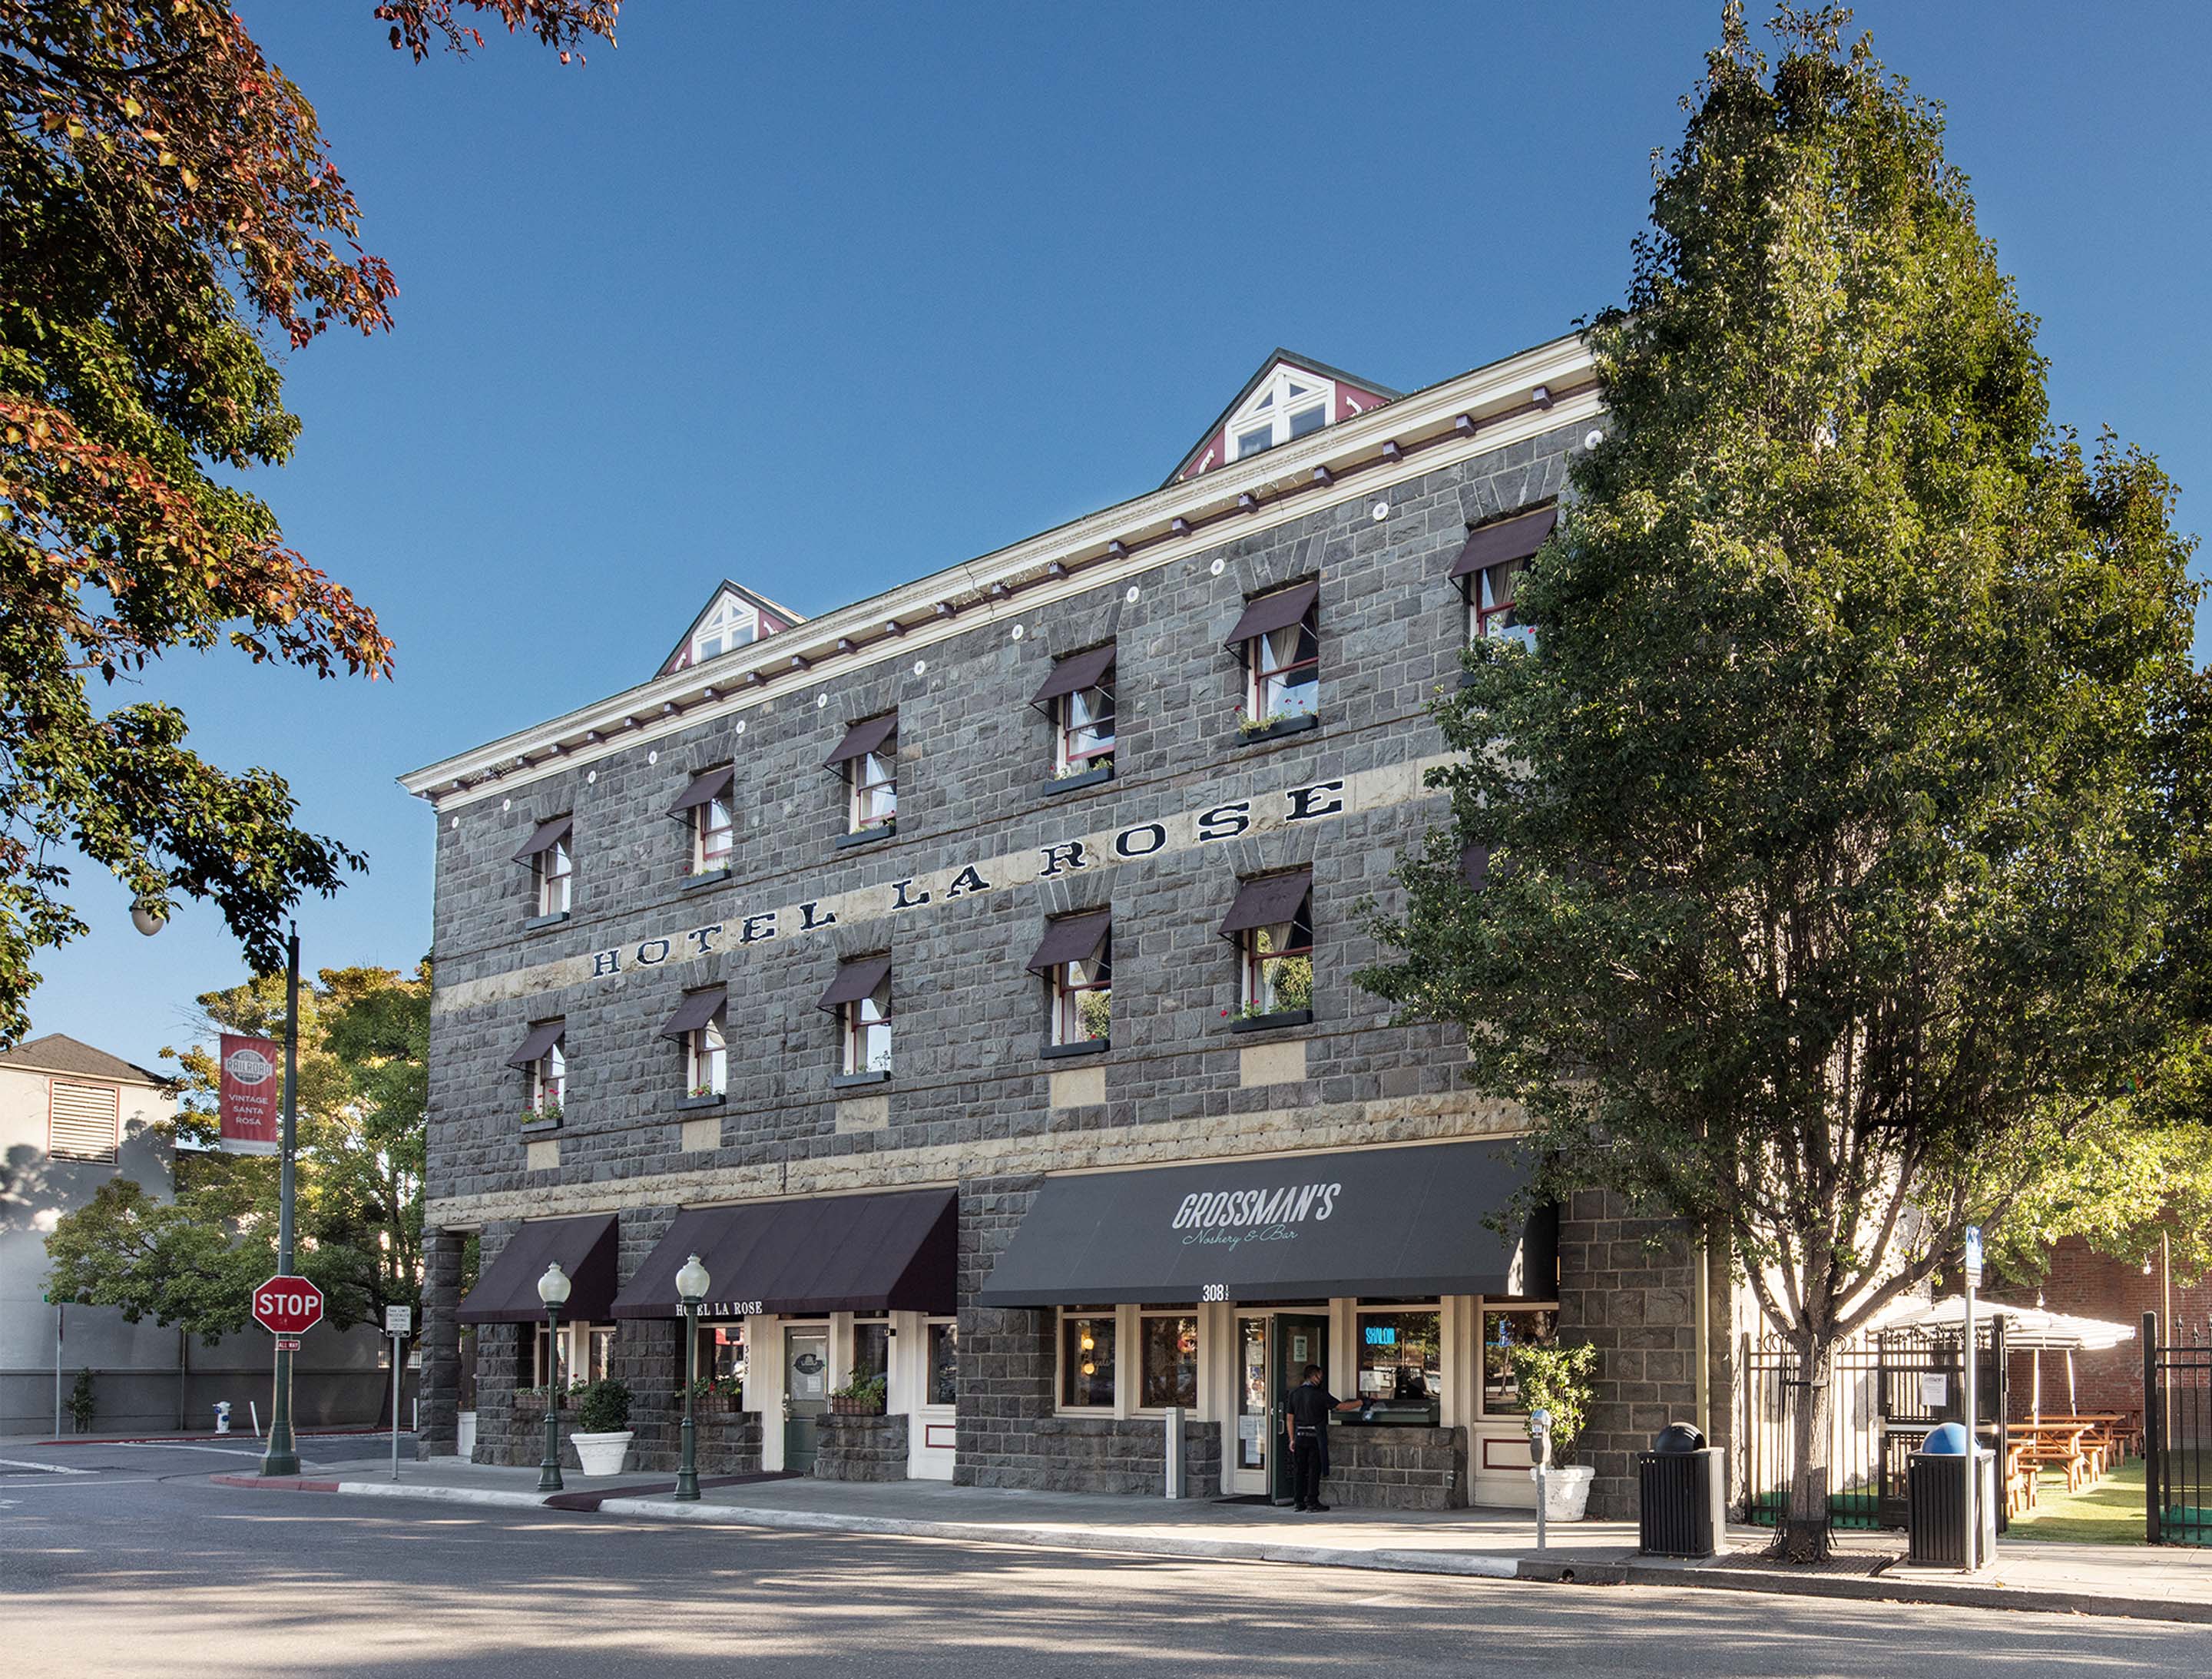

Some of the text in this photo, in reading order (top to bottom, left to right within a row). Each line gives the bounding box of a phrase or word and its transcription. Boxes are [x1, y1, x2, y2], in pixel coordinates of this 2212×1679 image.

[592, 780, 1345, 978] HOTEL LA ROSE
[227, 1060, 270, 1075] RAILROAD
[228, 1094, 268, 1104] VINTAGE
[233, 1105, 263, 1114] SANTA
[236, 1116, 261, 1126] ROSA
[1172, 1183, 1342, 1229] GROSSMAN'S
[1182, 1224, 1298, 1252] Noshery & Bar
[1203, 1283, 1224, 1302] 308
[259, 1293, 319, 1315] STOP
[676, 1300, 762, 1316] HEL LA ROSE
[1366, 1326, 1395, 1345] SHALOM
